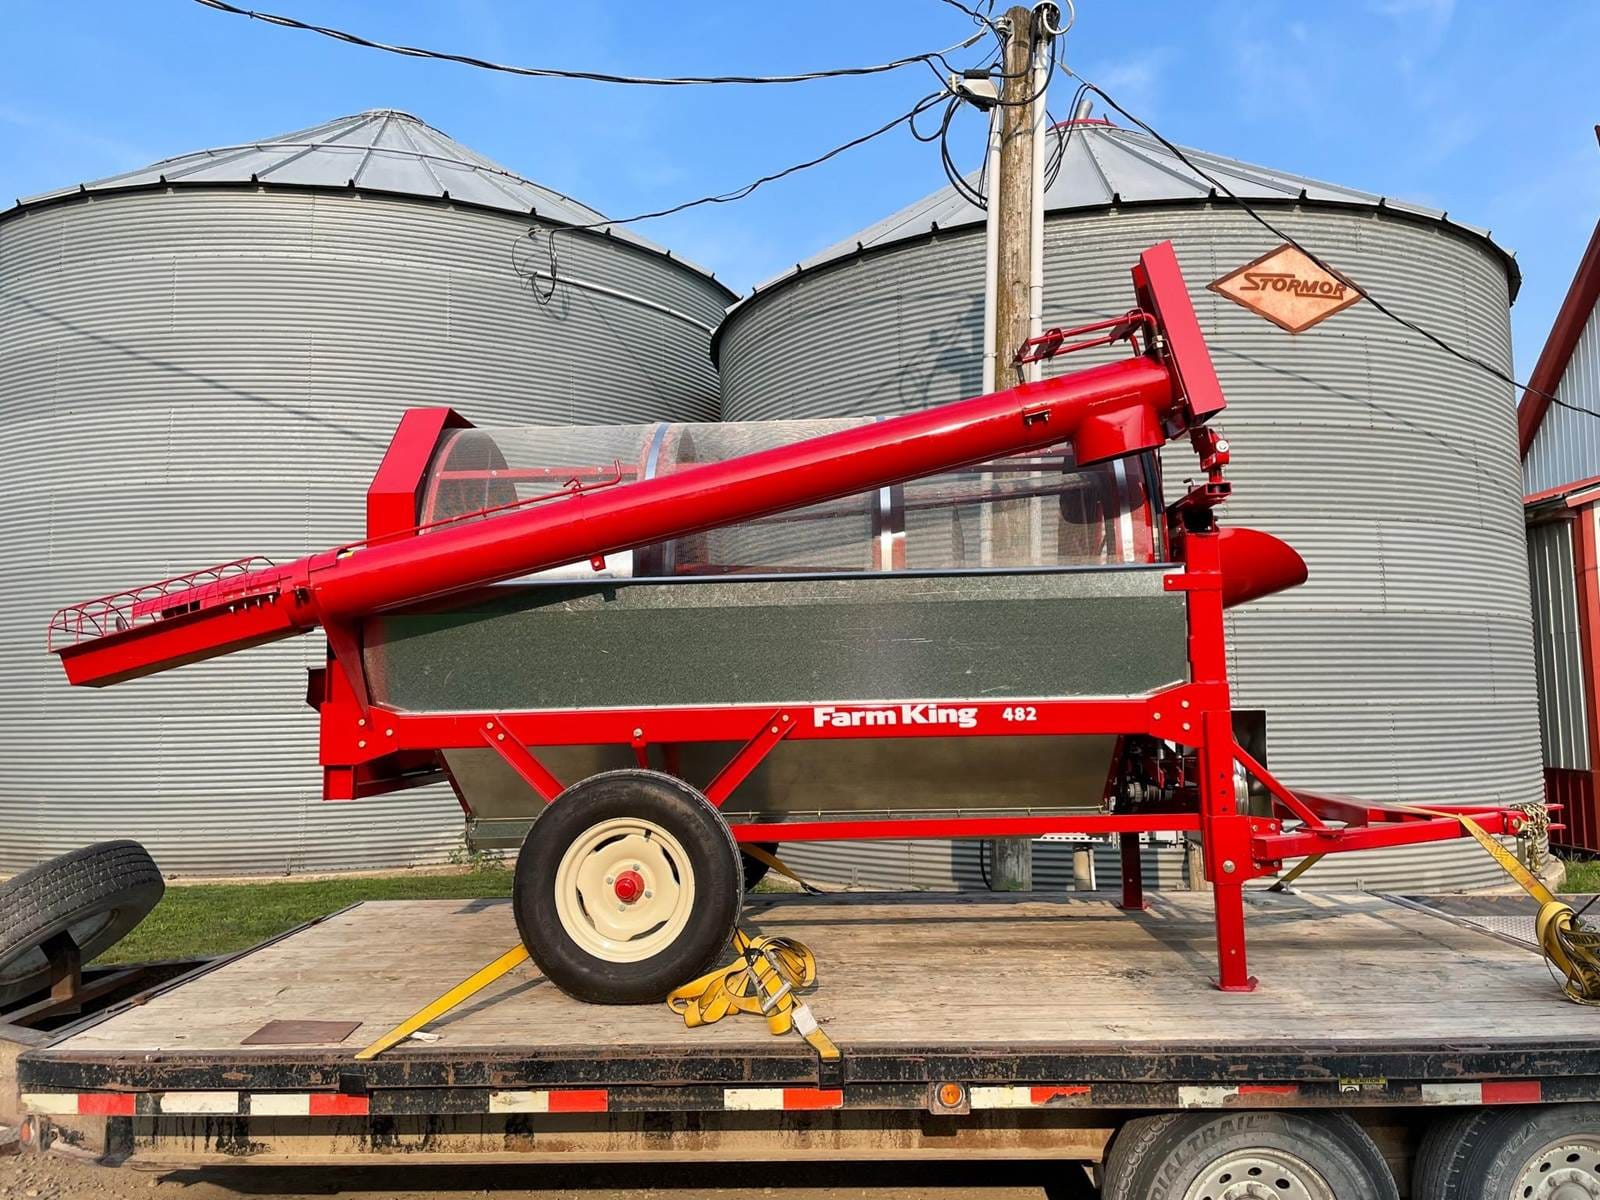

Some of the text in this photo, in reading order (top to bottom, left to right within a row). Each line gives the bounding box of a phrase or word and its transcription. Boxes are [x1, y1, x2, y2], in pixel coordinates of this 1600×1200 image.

[1240, 273, 1347, 300] STORMOR
[813, 704, 1037, 728] Farm King 482
